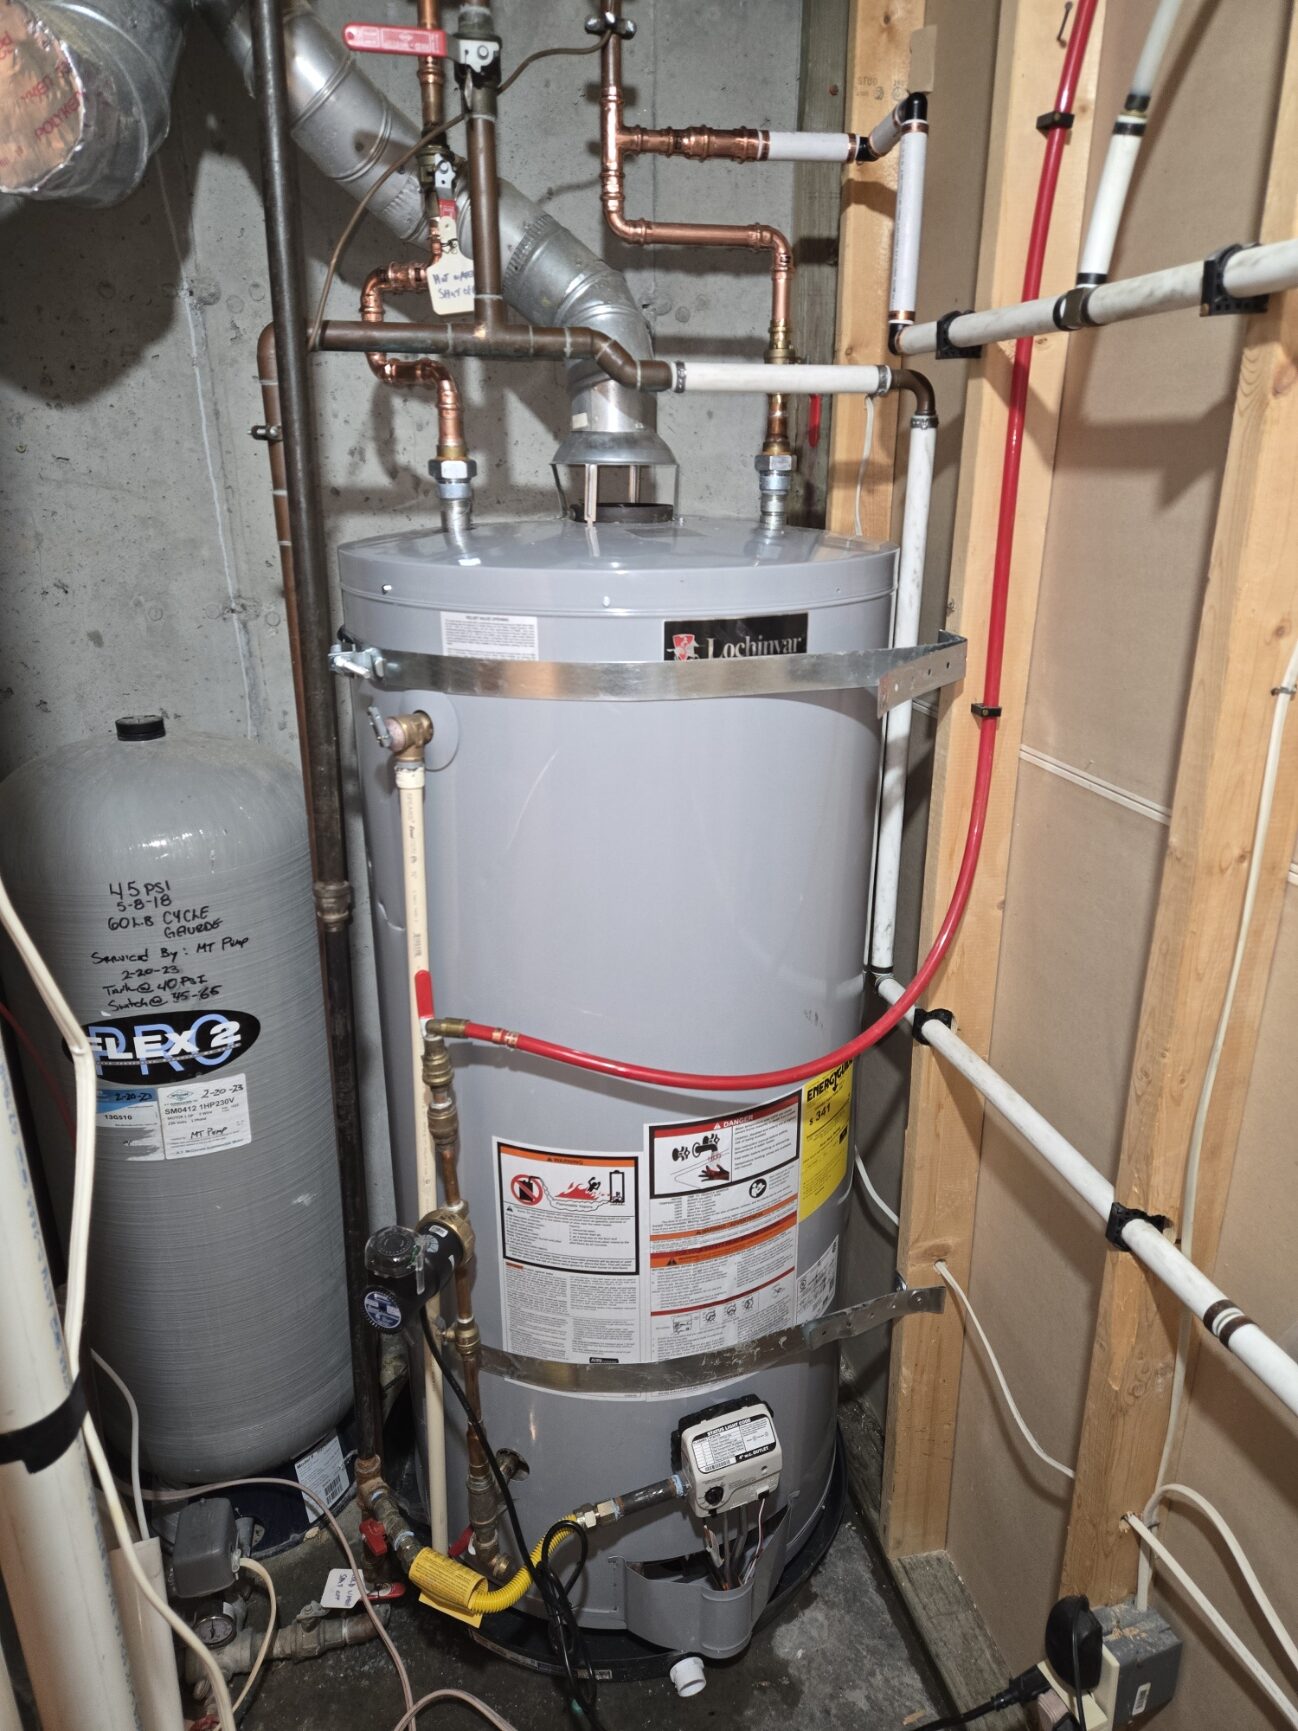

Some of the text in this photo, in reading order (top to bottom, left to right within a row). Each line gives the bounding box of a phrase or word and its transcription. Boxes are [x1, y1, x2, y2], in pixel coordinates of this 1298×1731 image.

[706, 634, 802, 660] Lochinvar
[109, 880, 171, 900] 45 PSI
[116, 893, 172, 912] 5-8-18
[162, 905, 209, 925] CYCLE
[196, 941, 216, 954] MT
[221, 936, 249, 951] Pump
[122, 965, 180, 981] 2-20-23
[164, 1105, 197, 1115] SM0412
[723, 1114, 754, 1128] DANGER
